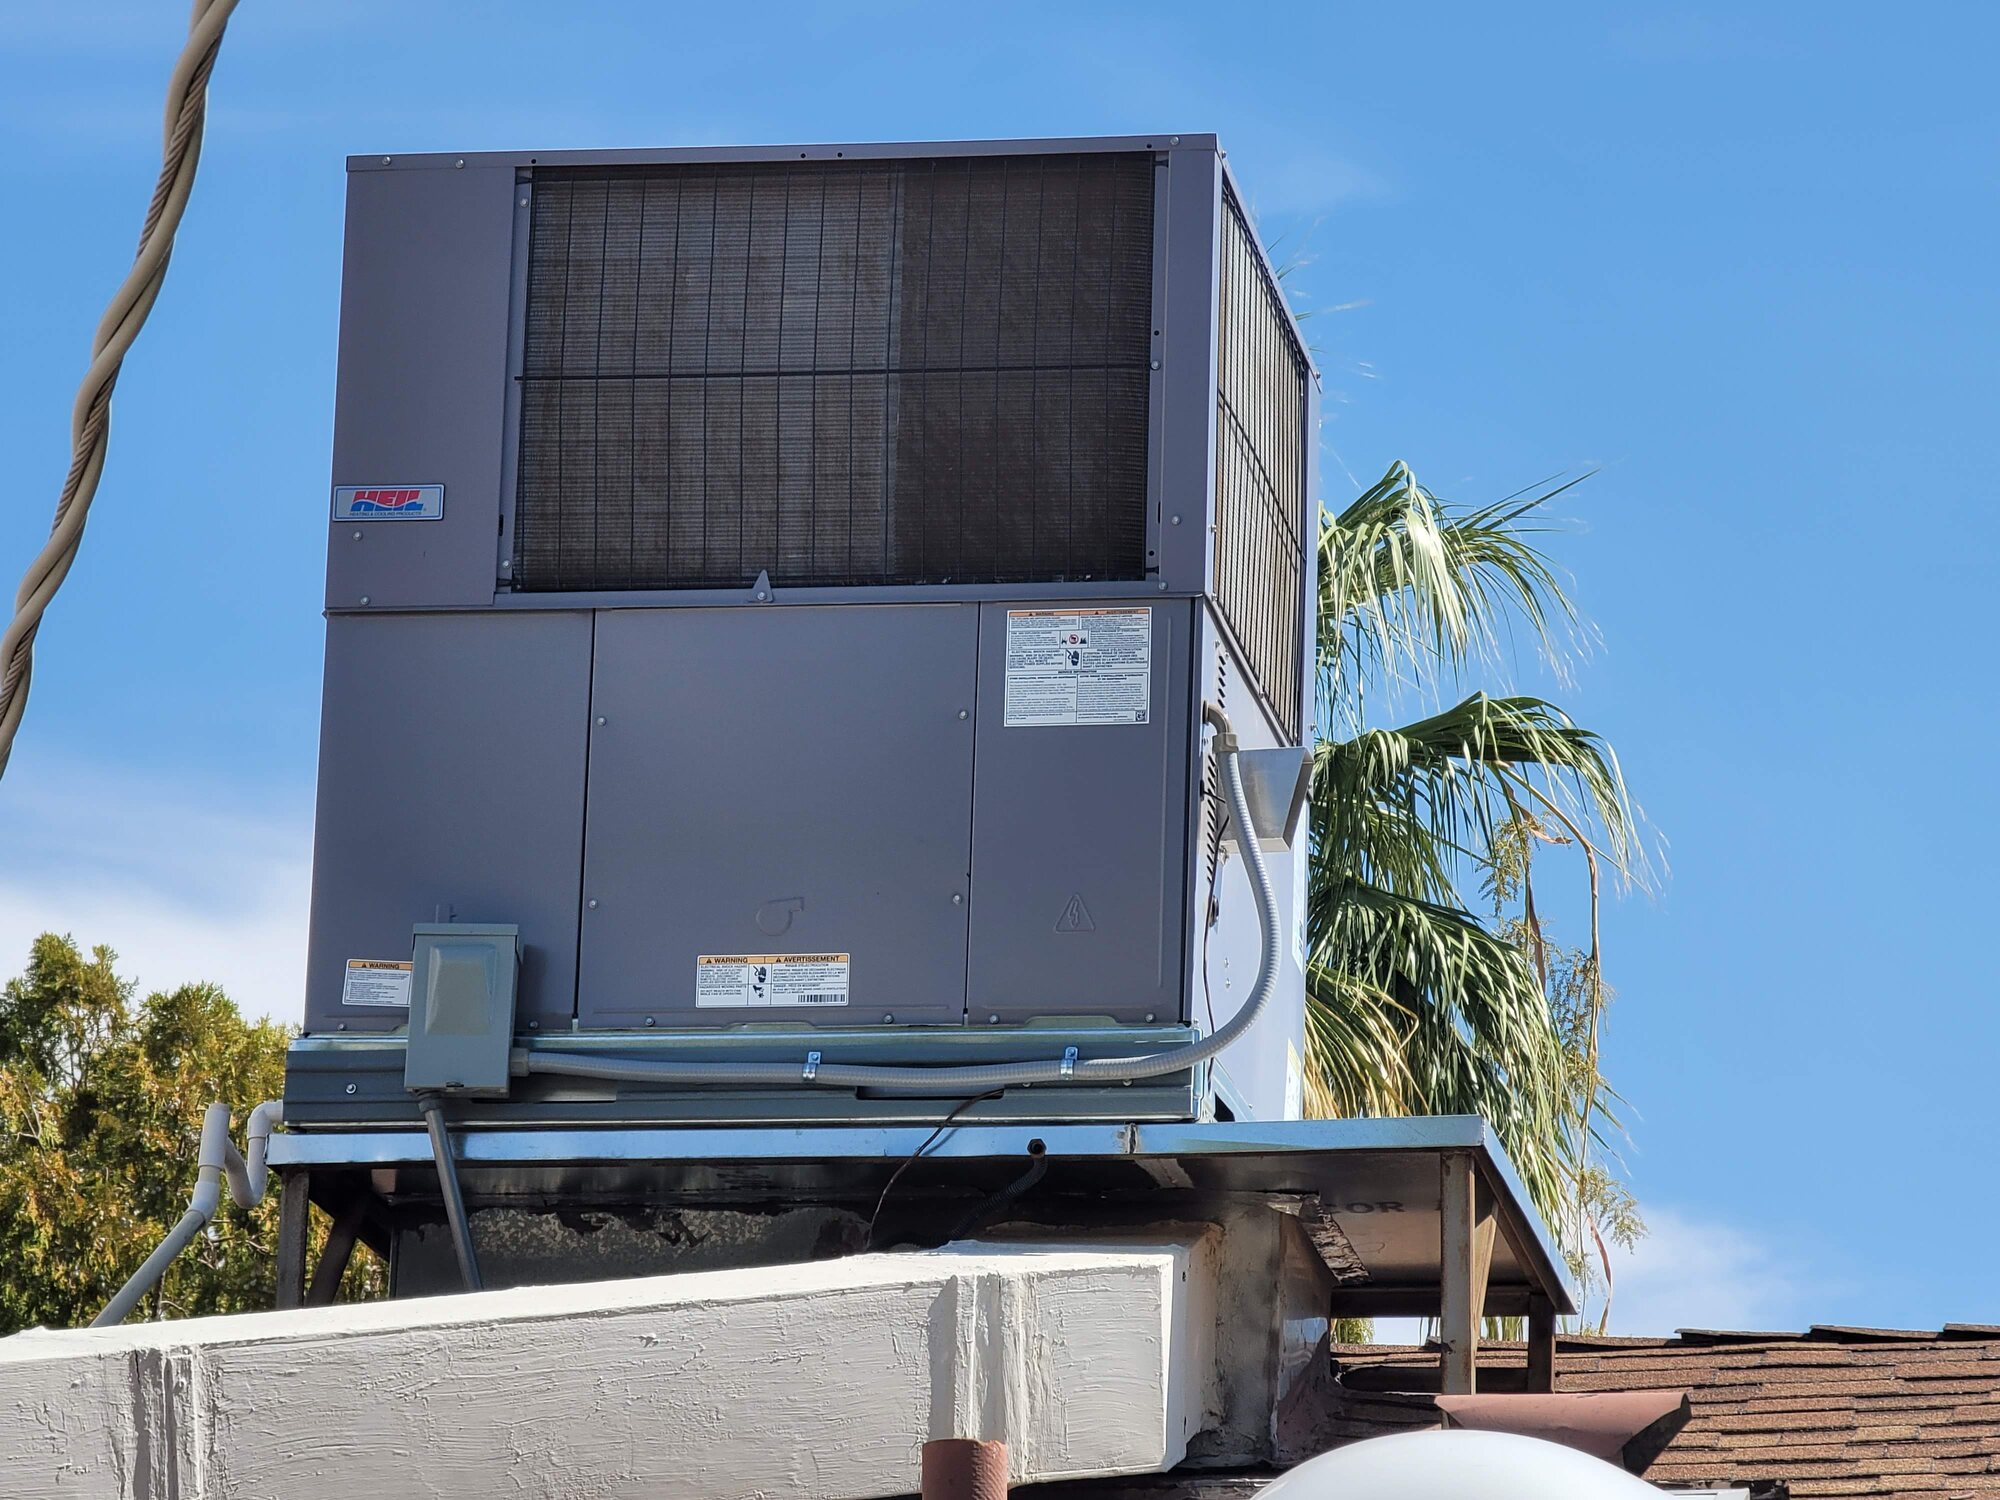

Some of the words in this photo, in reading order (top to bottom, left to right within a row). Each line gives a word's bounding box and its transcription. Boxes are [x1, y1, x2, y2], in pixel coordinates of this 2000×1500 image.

[350, 489, 424, 511] HEIL
[783, 955, 840, 963] AVERTISSEMENT
[368, 962, 400, 970] WARNING
